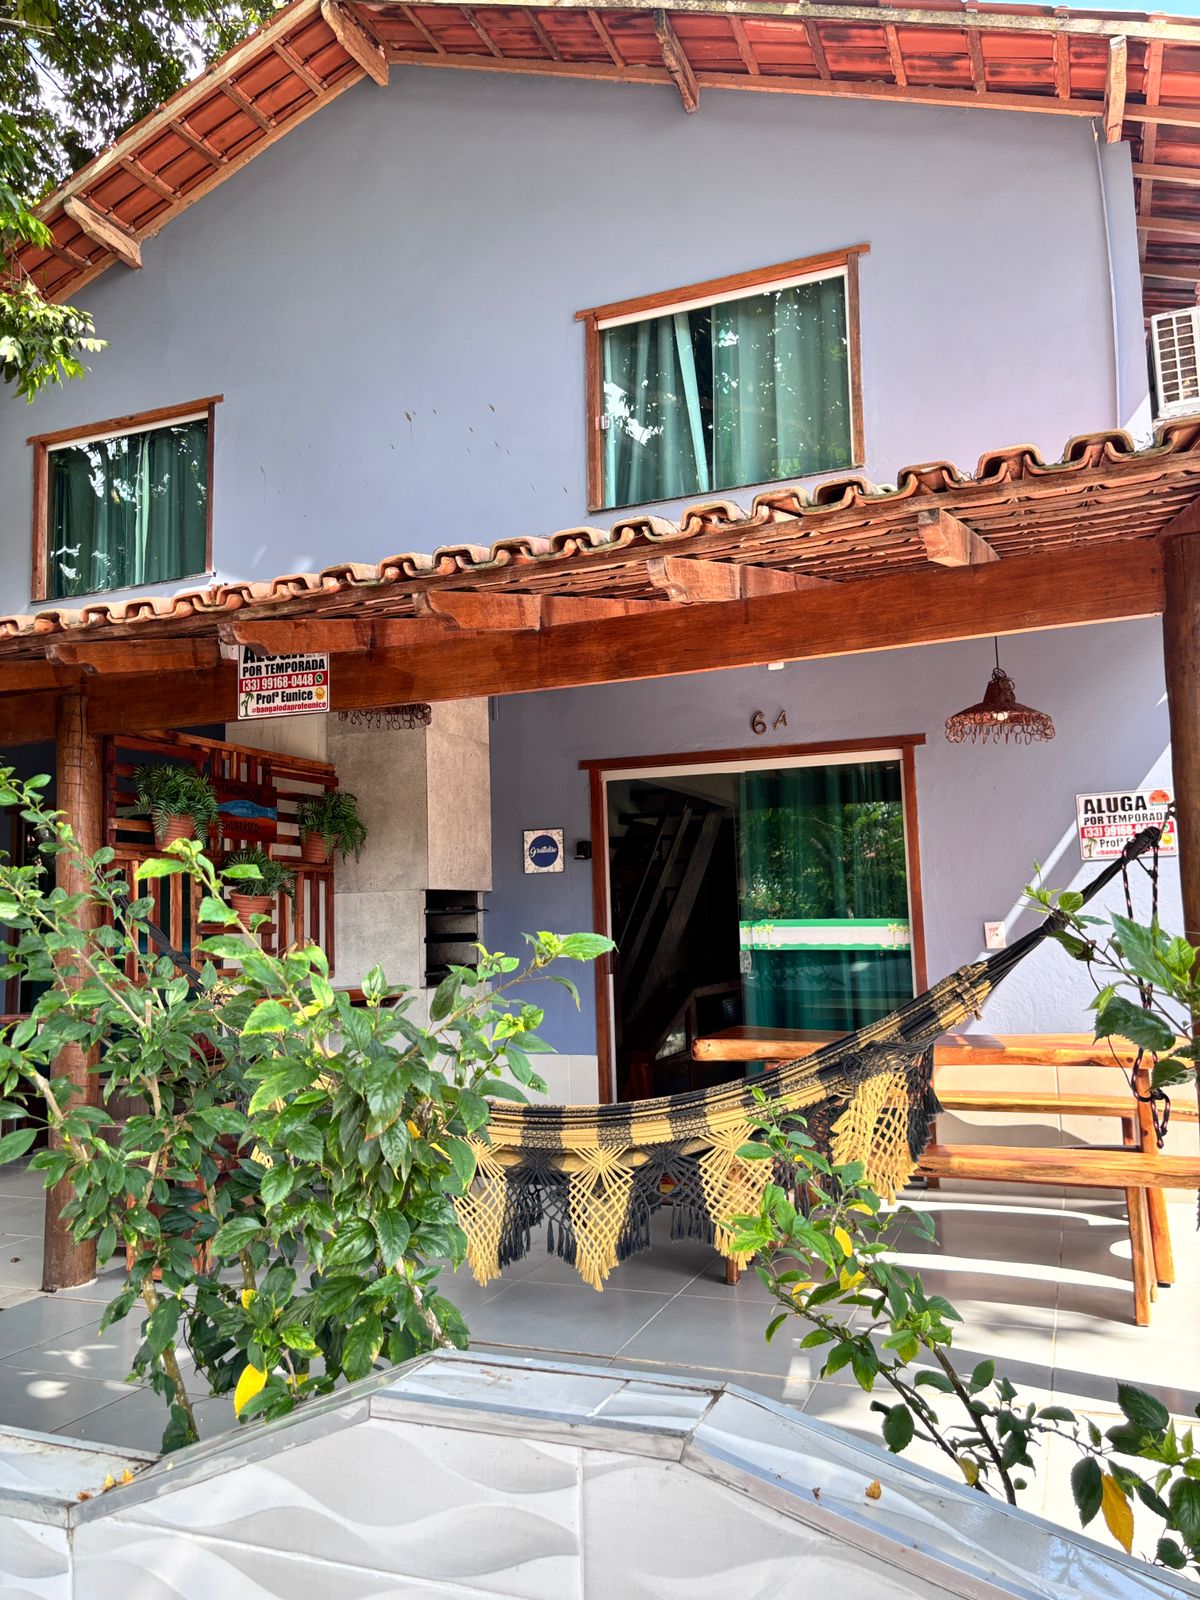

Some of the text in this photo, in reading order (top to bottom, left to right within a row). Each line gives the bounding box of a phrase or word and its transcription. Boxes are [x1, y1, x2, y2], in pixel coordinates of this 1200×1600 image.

[243, 658, 325, 677] POR TEMPORADA
[242, 673, 314, 692] (33) 99168-0448
[281, 690, 313, 703] Eunice
[1084, 795, 1147, 815] ALUGA
[1084, 816, 1104, 826] POR
[1084, 827, 1103, 838] (33)
